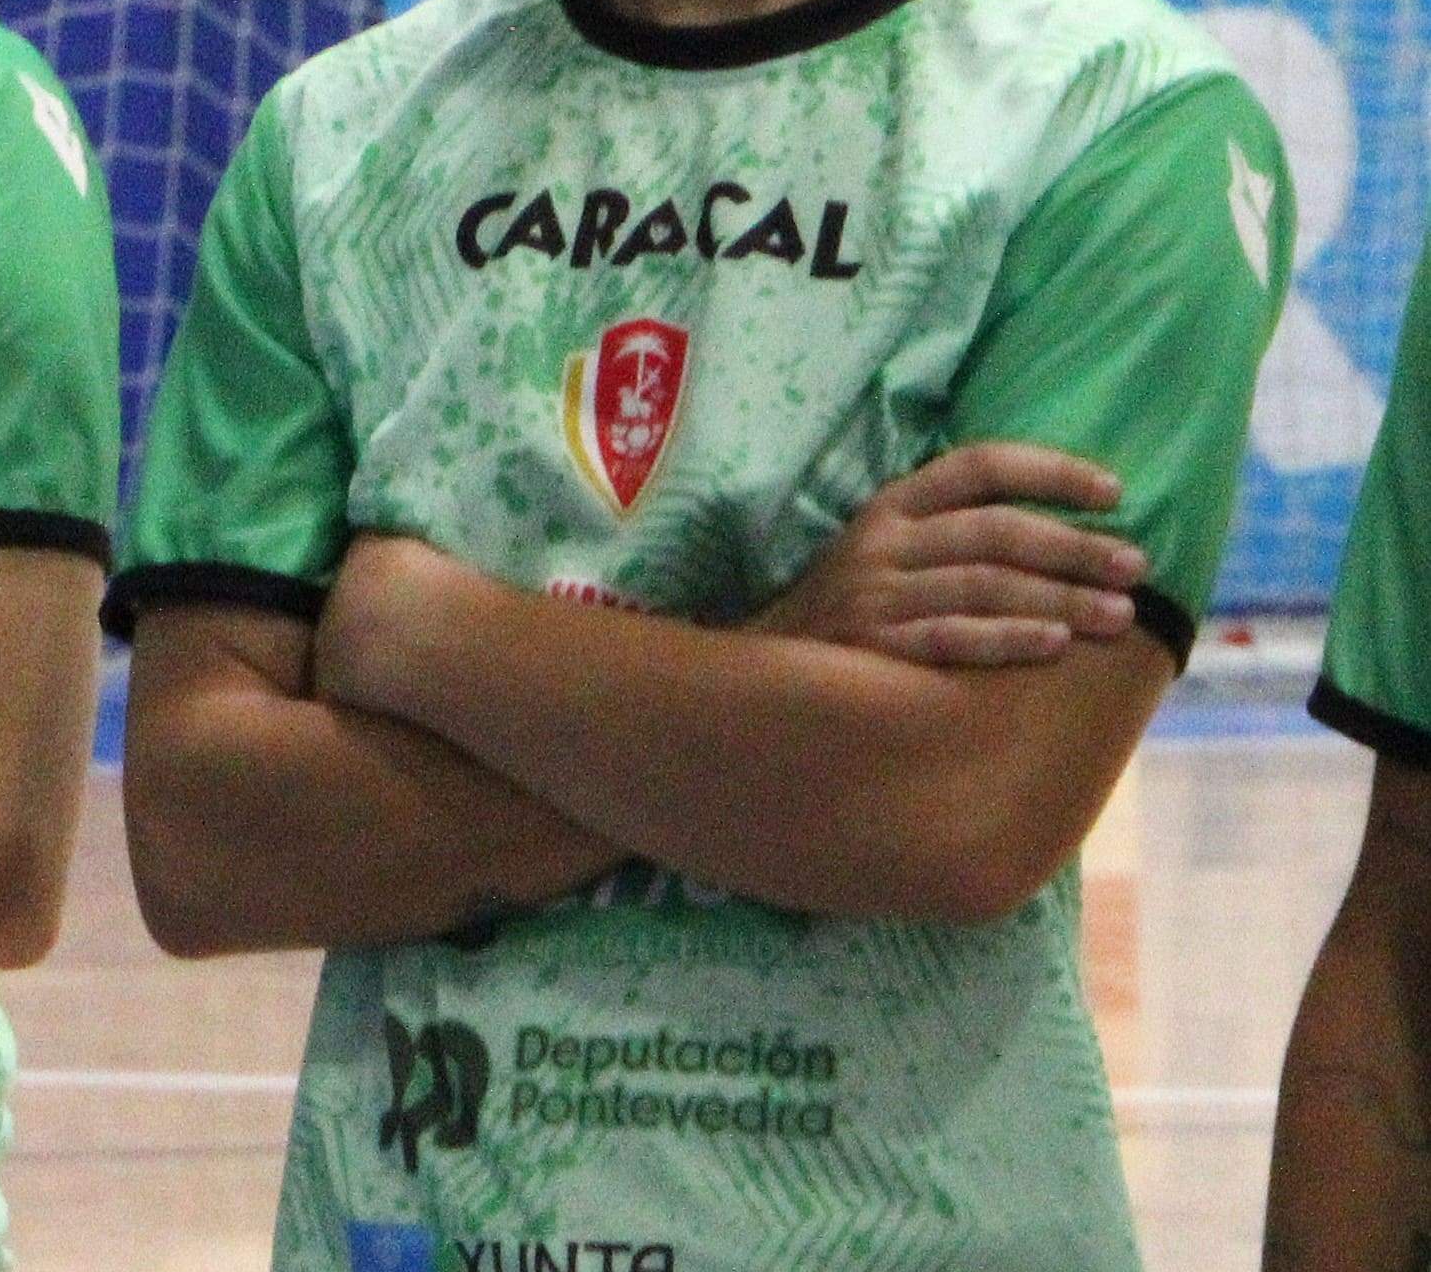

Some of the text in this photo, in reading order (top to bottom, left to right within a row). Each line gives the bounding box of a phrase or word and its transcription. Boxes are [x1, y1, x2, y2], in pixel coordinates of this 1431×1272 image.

[456, 182, 862, 279] CARACAL
[515, 1026, 837, 1083] Deputación
[510, 1084, 834, 1135] Pontevedra
